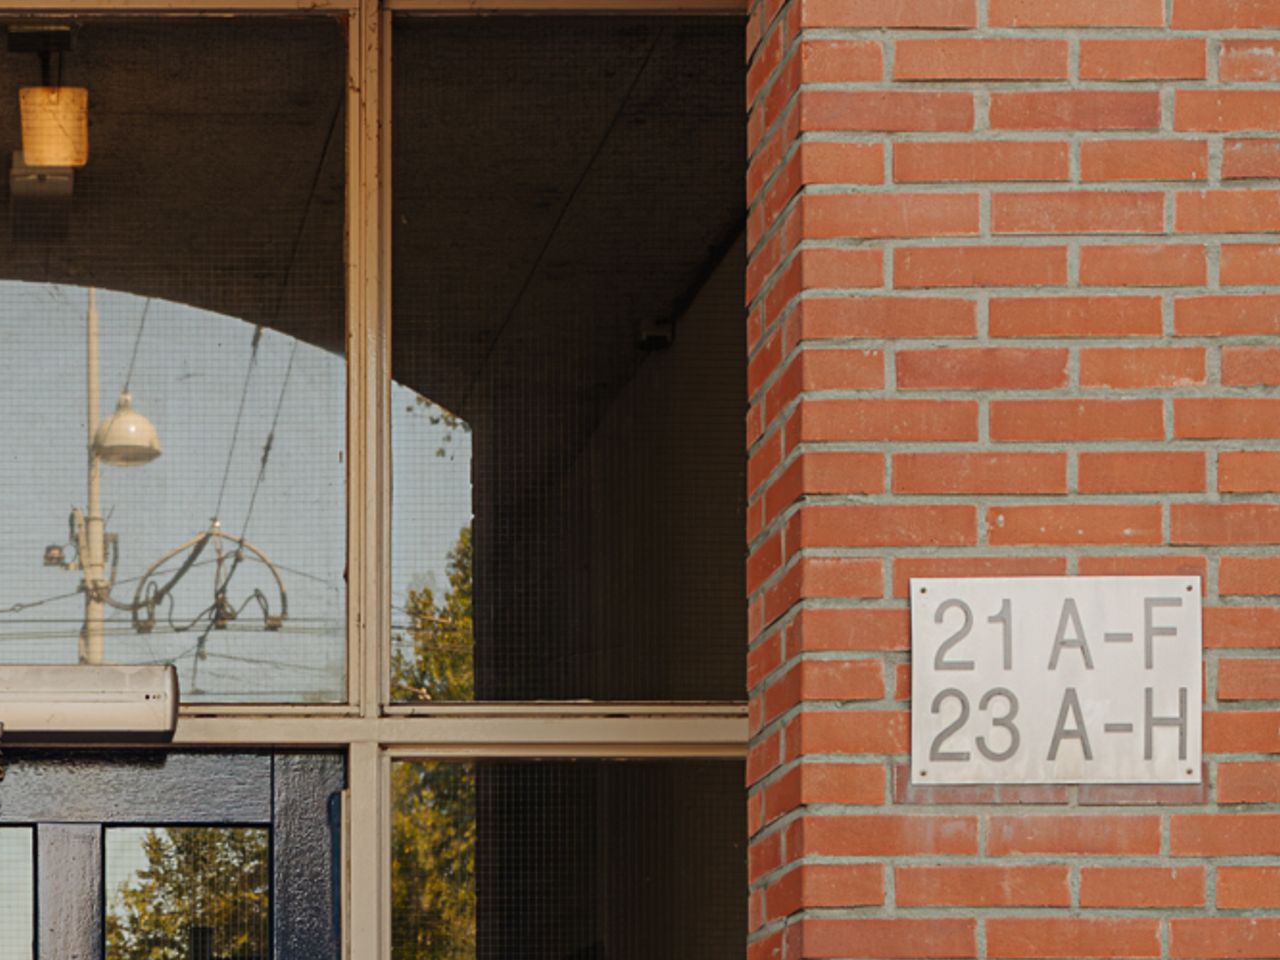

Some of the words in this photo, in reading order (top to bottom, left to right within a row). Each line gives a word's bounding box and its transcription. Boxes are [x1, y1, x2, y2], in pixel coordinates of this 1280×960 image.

[933, 597, 1013, 671] 21
[1047, 596, 1184, 671] A-F
[928, 686, 1021, 763] 23
[1046, 686, 1188, 762] A-H
